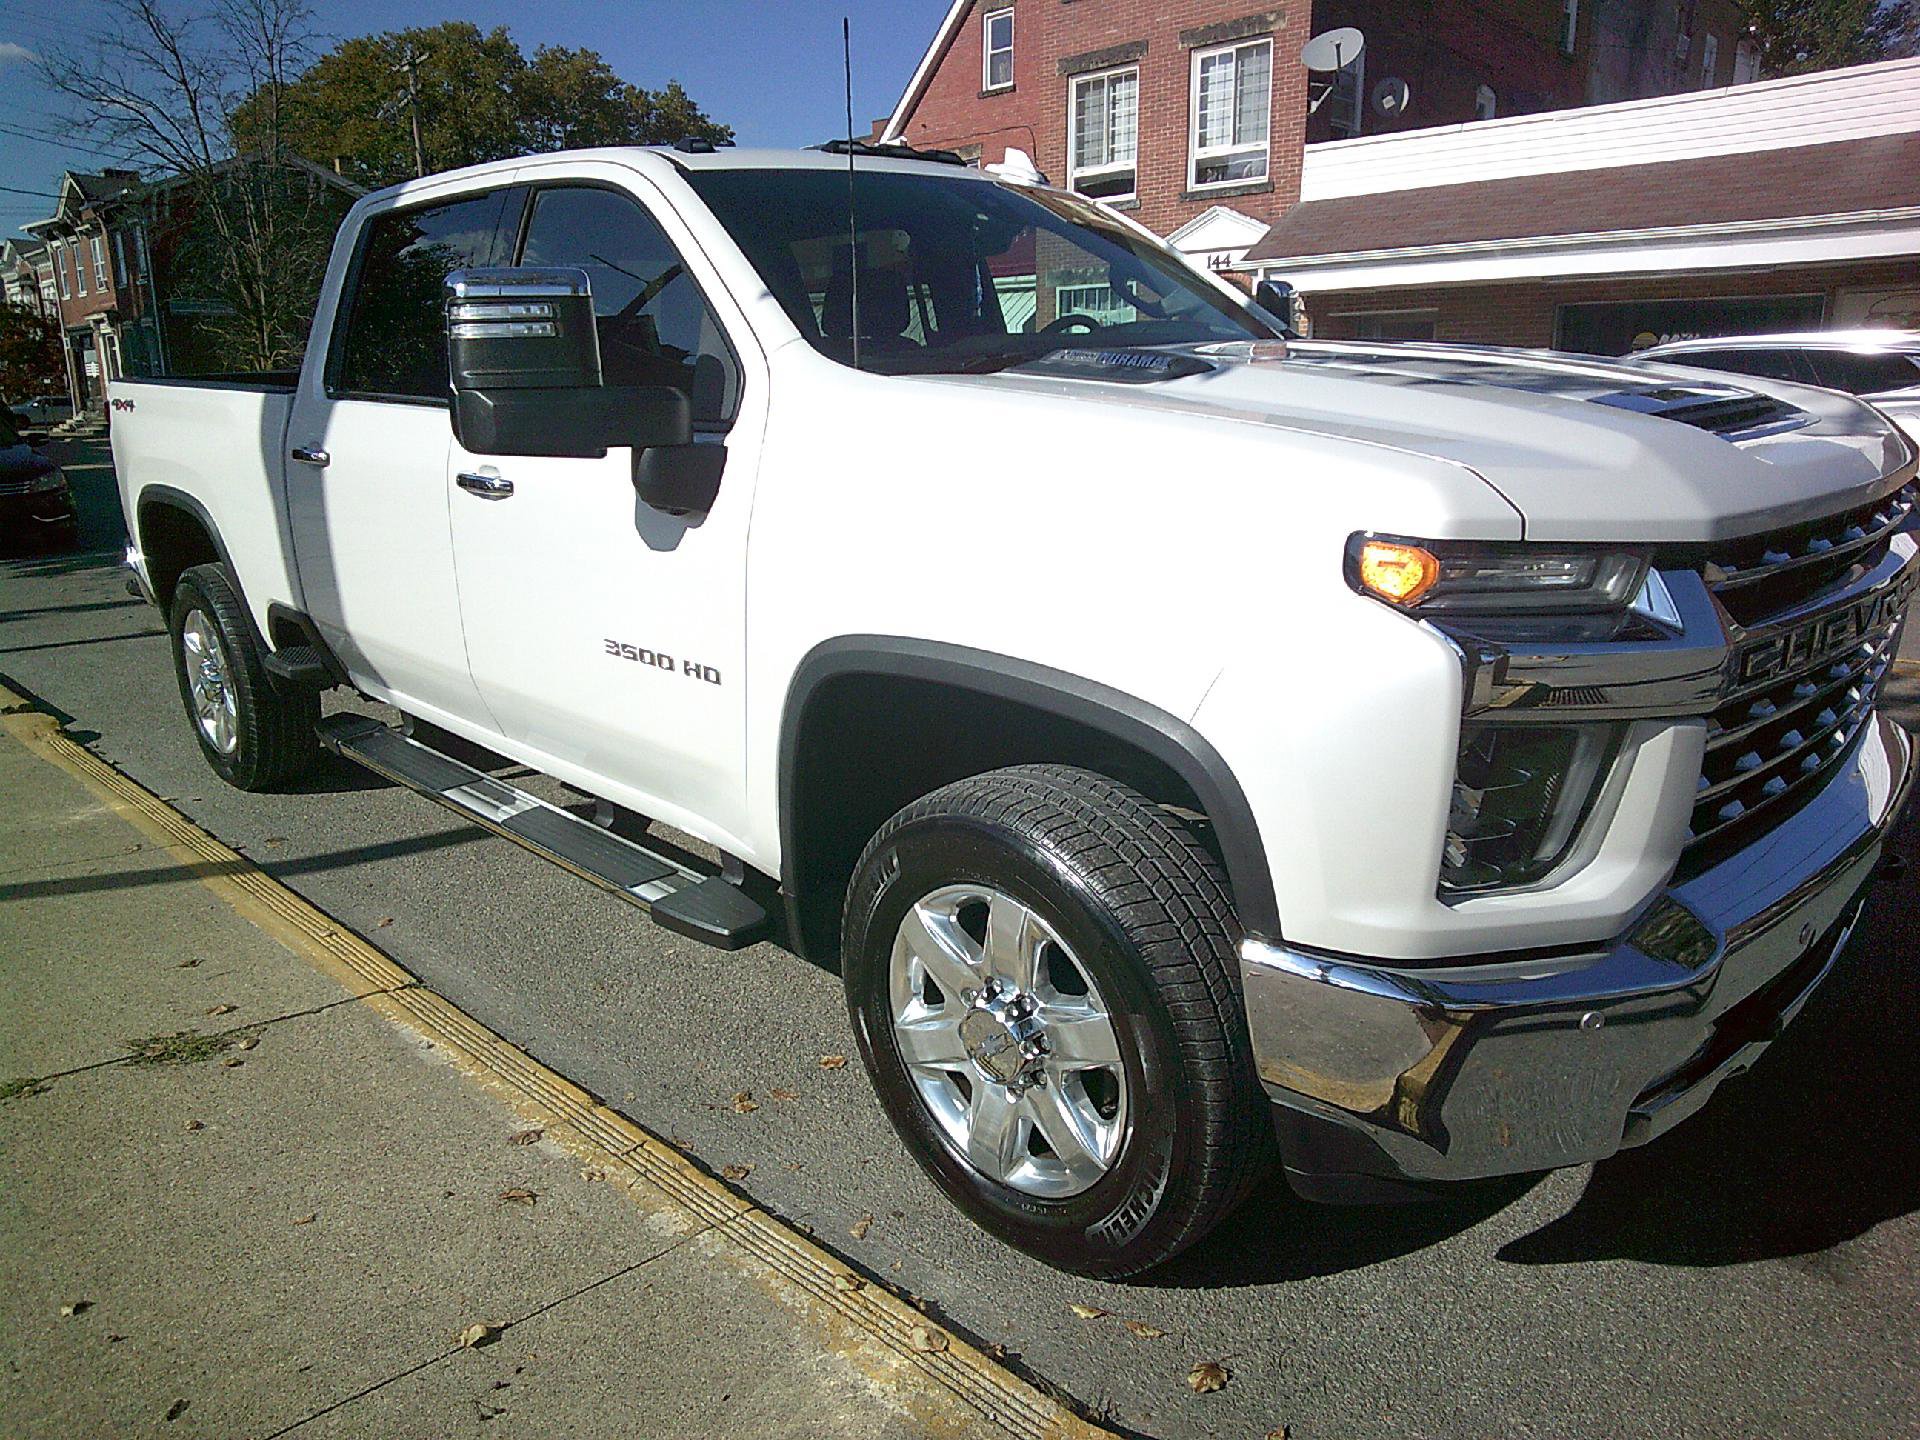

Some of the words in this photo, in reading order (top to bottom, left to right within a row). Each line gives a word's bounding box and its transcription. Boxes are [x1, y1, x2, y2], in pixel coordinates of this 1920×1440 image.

[1206, 253, 1231, 269] 144
[603, 638, 675, 672] 3500
[683, 659, 721, 685] HD
